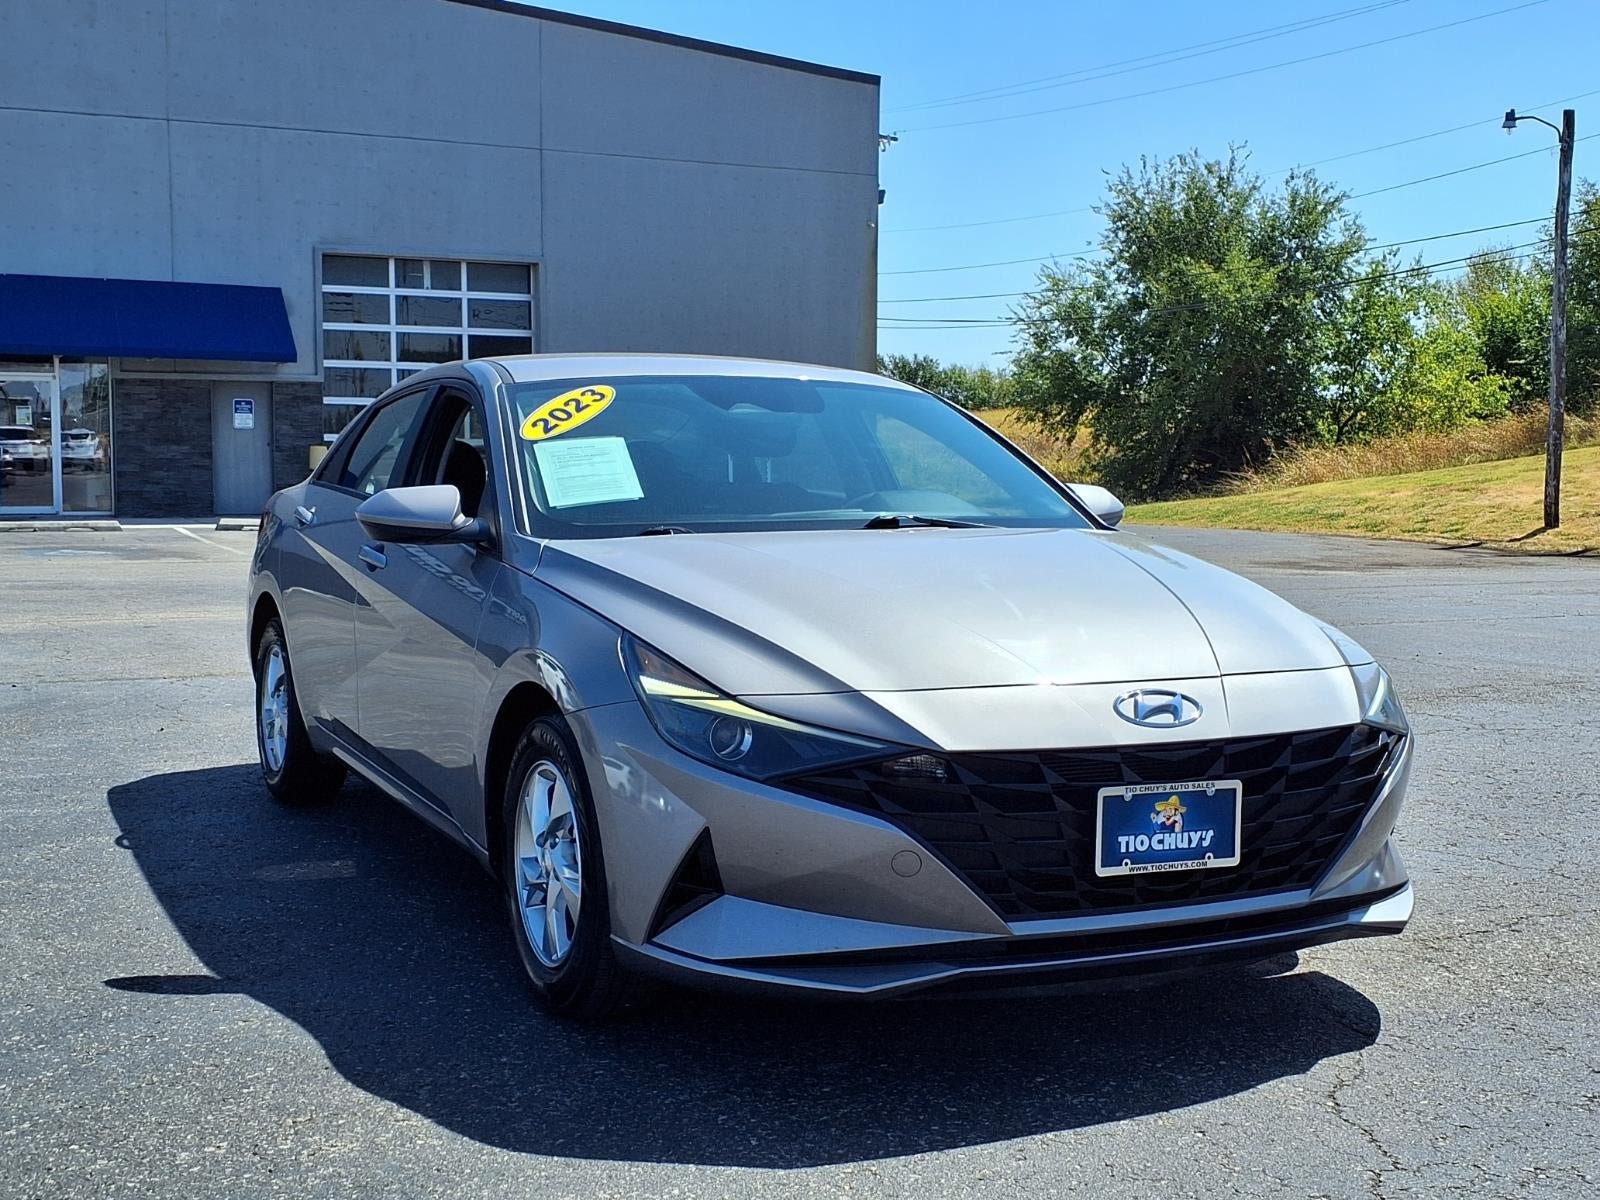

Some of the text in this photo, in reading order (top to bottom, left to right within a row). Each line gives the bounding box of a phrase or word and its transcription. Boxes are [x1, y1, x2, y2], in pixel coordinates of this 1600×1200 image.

[531, 389, 605, 435] 2023
[1139, 785, 1167, 793] CHUY'S
[1168, 783, 1190, 791] AUTO
[1128, 860, 1208, 873] WWW.TIOCHUYS.COM
